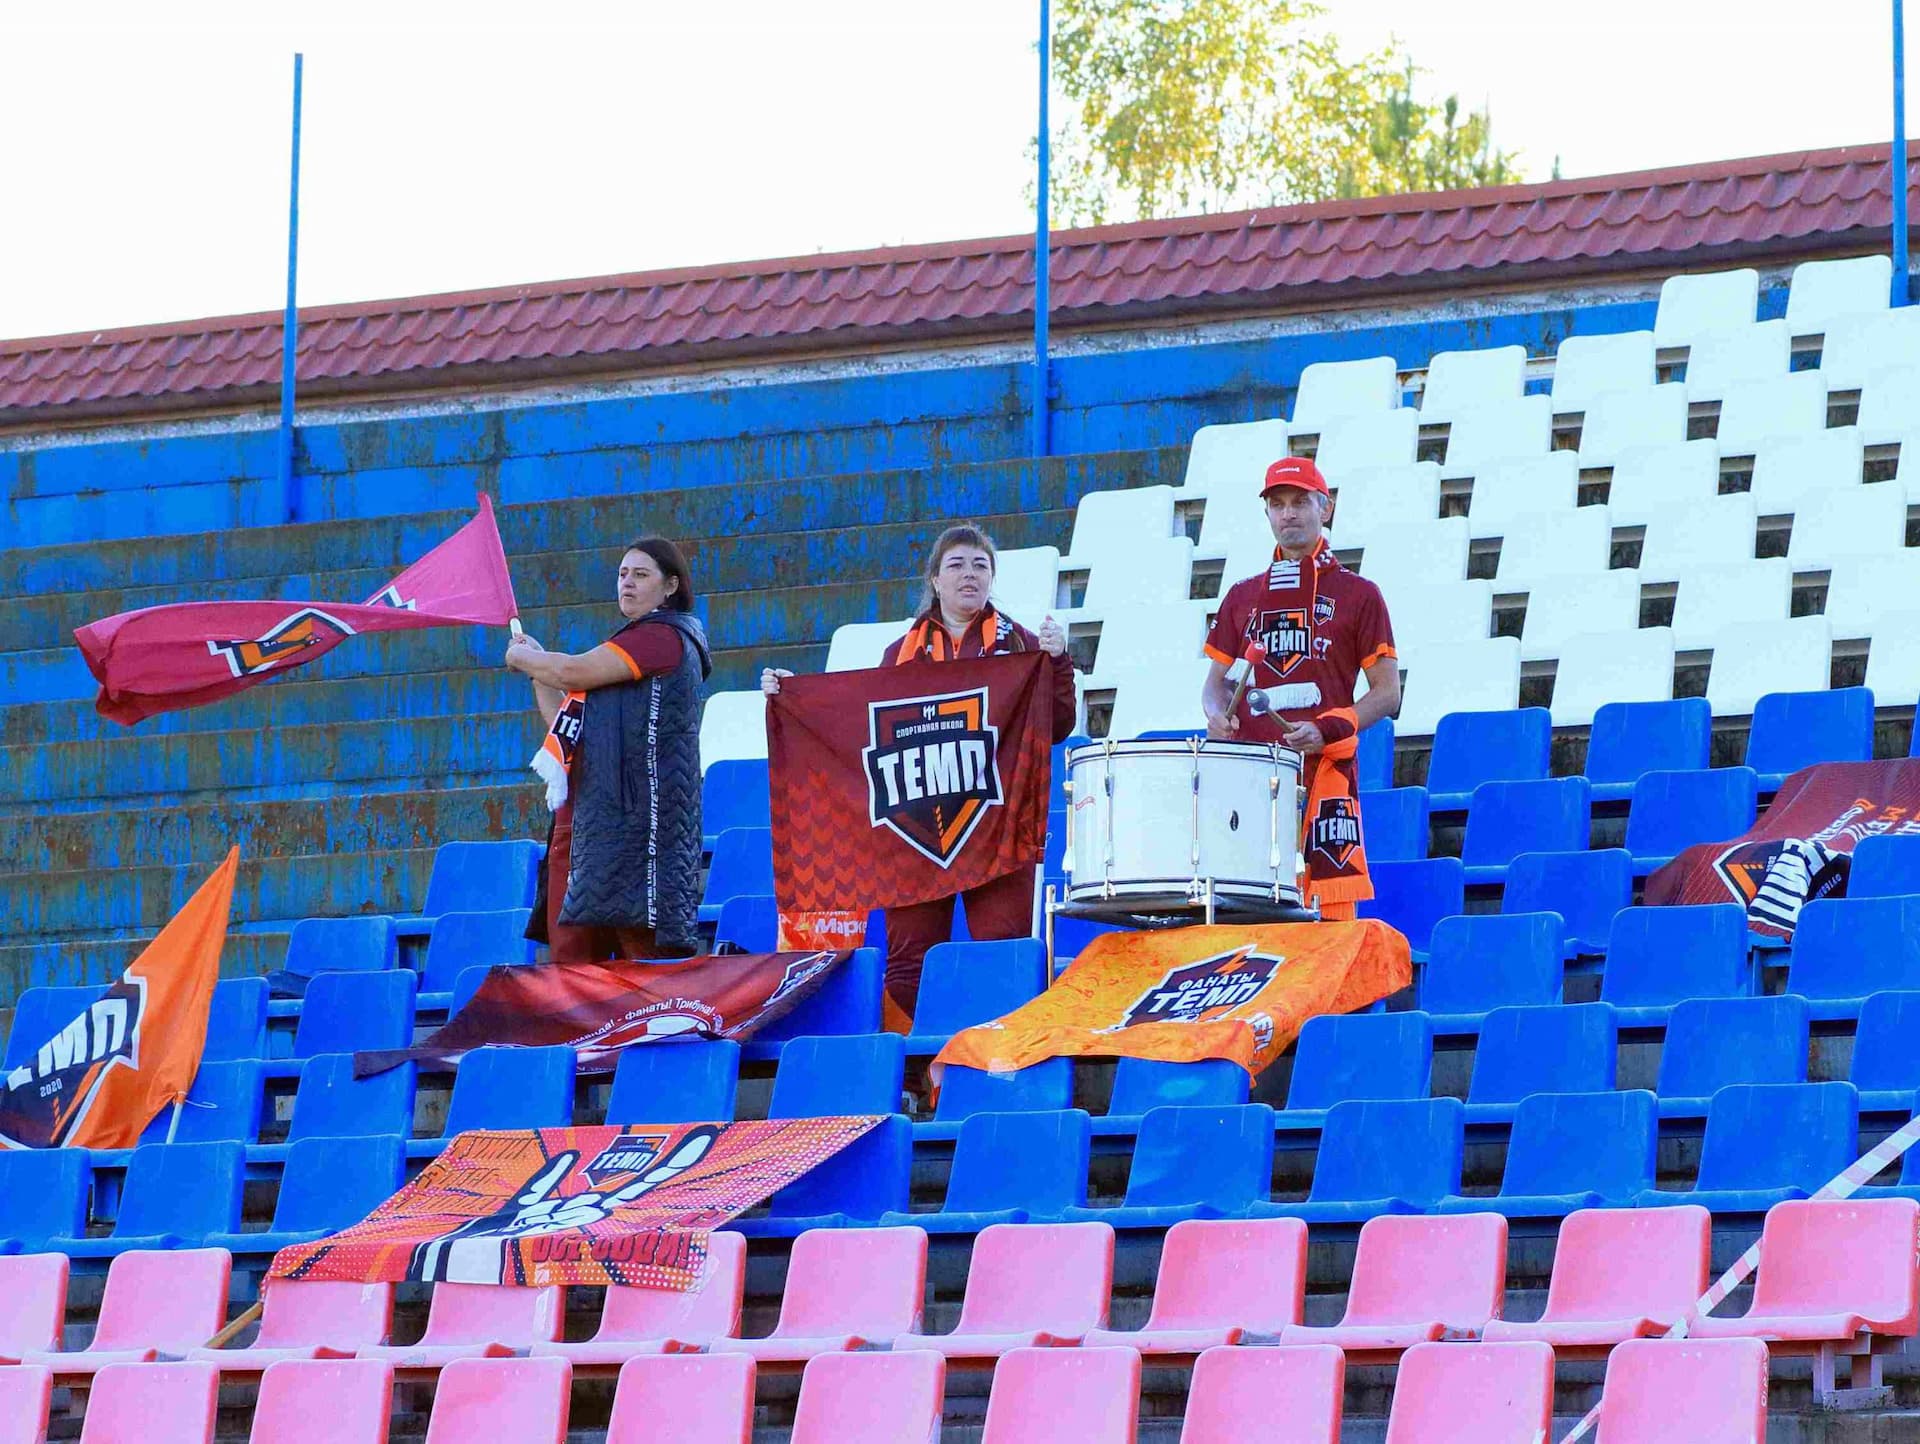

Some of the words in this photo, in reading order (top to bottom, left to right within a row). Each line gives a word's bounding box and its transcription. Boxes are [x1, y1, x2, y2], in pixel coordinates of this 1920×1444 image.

[1262, 629, 1306, 655] ТЕМП
[558, 714, 581, 740] ТЕ
[895, 722, 940, 739] СПОРТИВНАЯ
[940, 719, 965, 731] ШКОЛА
[877, 740, 988, 807] ТЕМП
[1318, 817, 1358, 843] ТЕМП
[1178, 972, 1256, 991] ФАНАТЫ
[1148, 981, 1262, 1014] ТЕМП
[563, 1018, 615, 1046] оманда!
[625, 998, 672, 1020] фанаты!
[592, 1151, 654, 1171] ТЕМП
